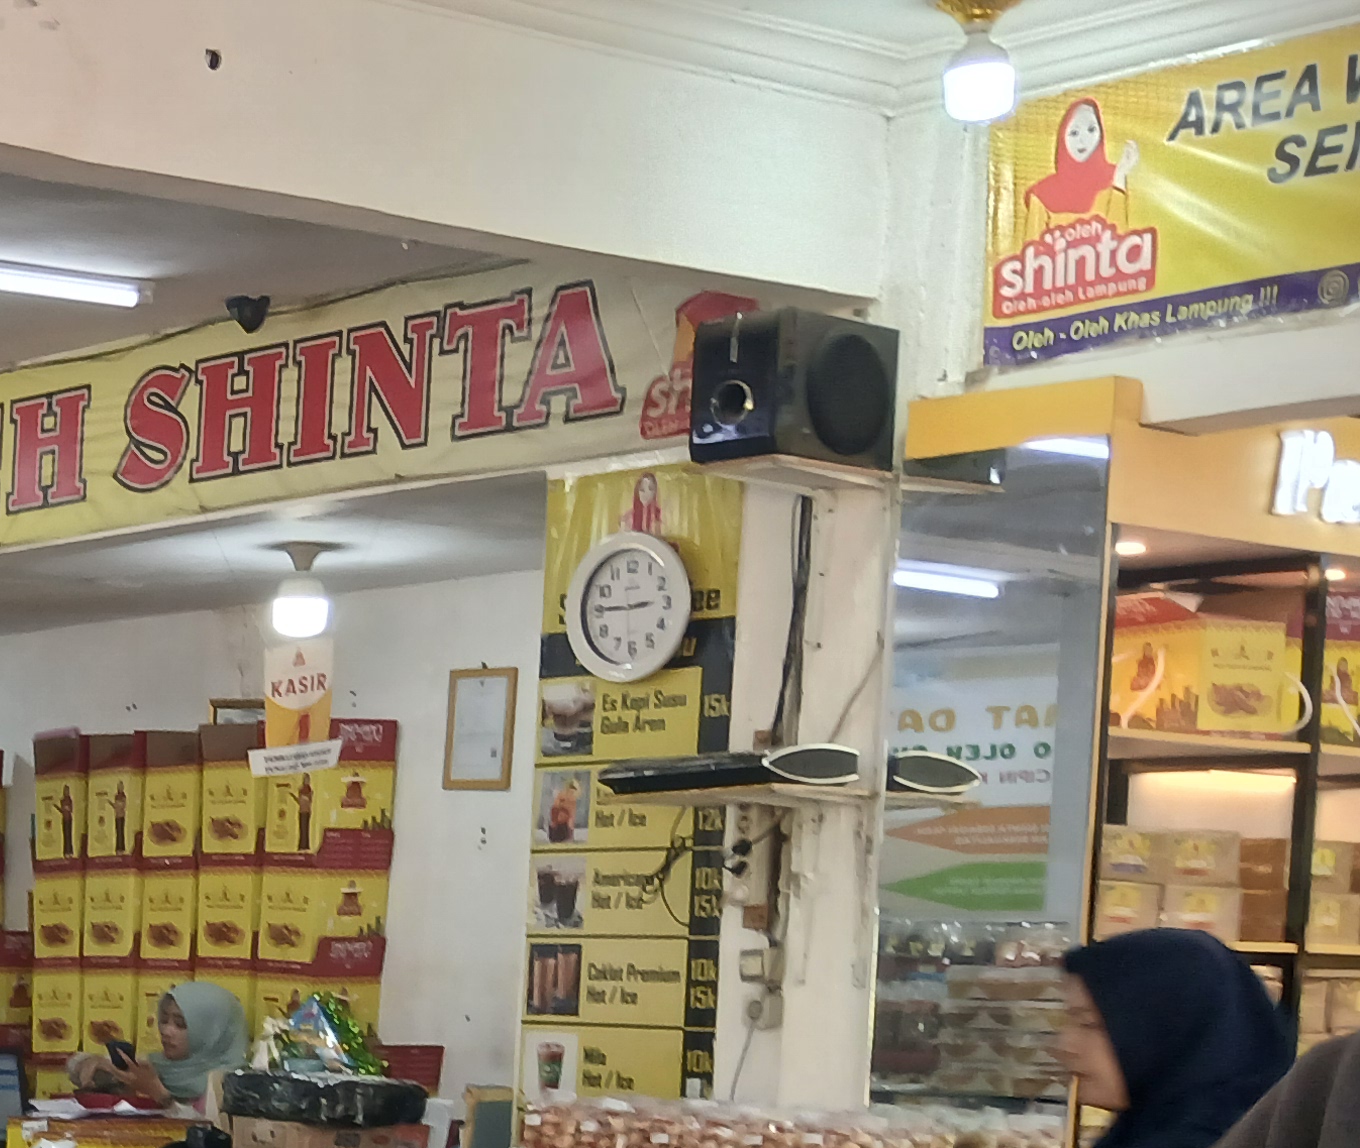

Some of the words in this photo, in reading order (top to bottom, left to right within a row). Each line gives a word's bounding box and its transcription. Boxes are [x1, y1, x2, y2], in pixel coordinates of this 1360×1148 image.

[1165, 62, 1323, 144] AREA
[999, 231, 1153, 298] shinta
[113, 278, 628, 495] SHINTA
[270, 672, 328, 699] KASIR
